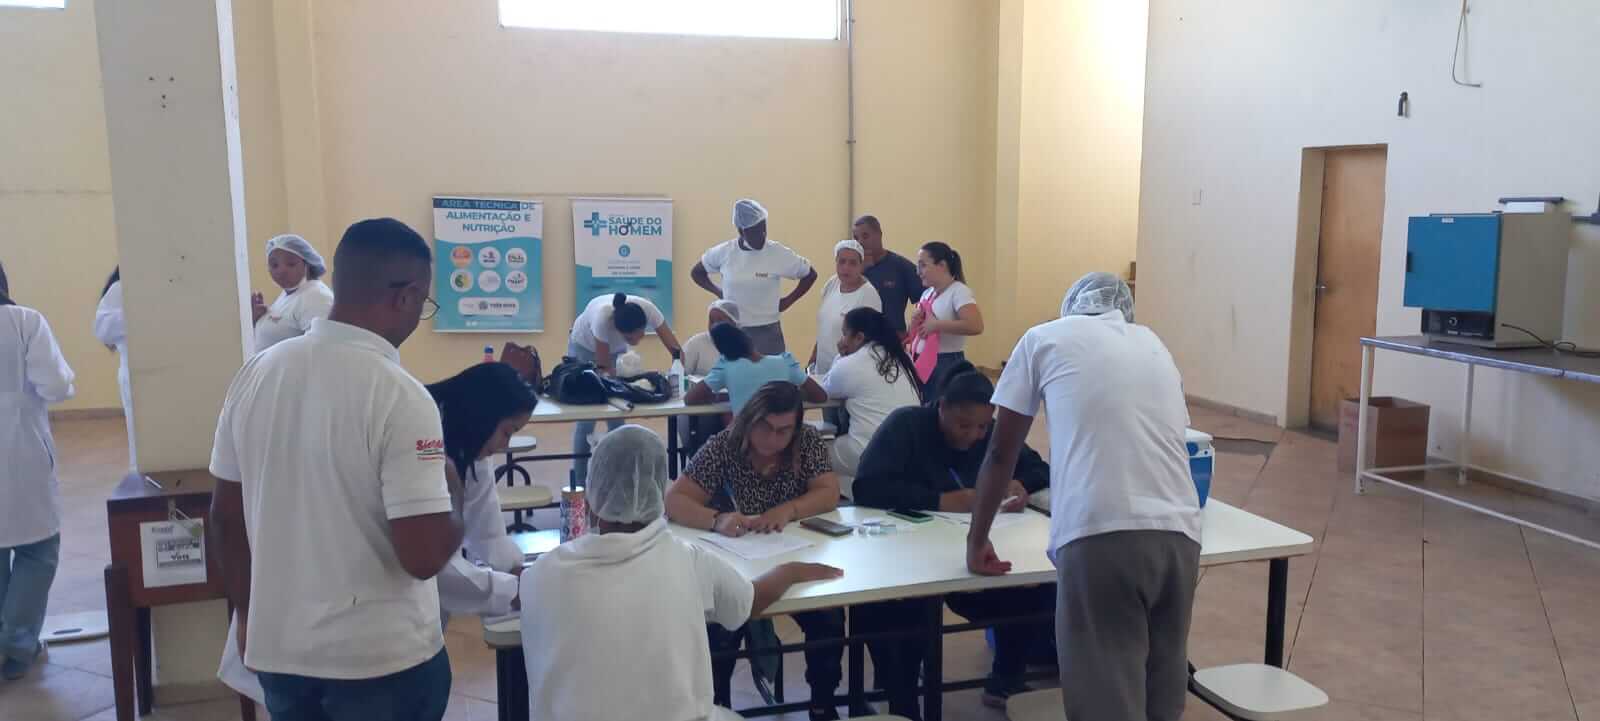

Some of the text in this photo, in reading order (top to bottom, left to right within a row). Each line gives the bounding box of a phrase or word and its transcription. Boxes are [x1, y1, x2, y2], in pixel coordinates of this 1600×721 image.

[520, 202, 535, 210] DE
[524, 213, 532, 222] E
[646, 216, 662, 225] DO
[462, 222, 516, 234] NUTRIÇÃO
[608, 224, 662, 236] HOMEM
